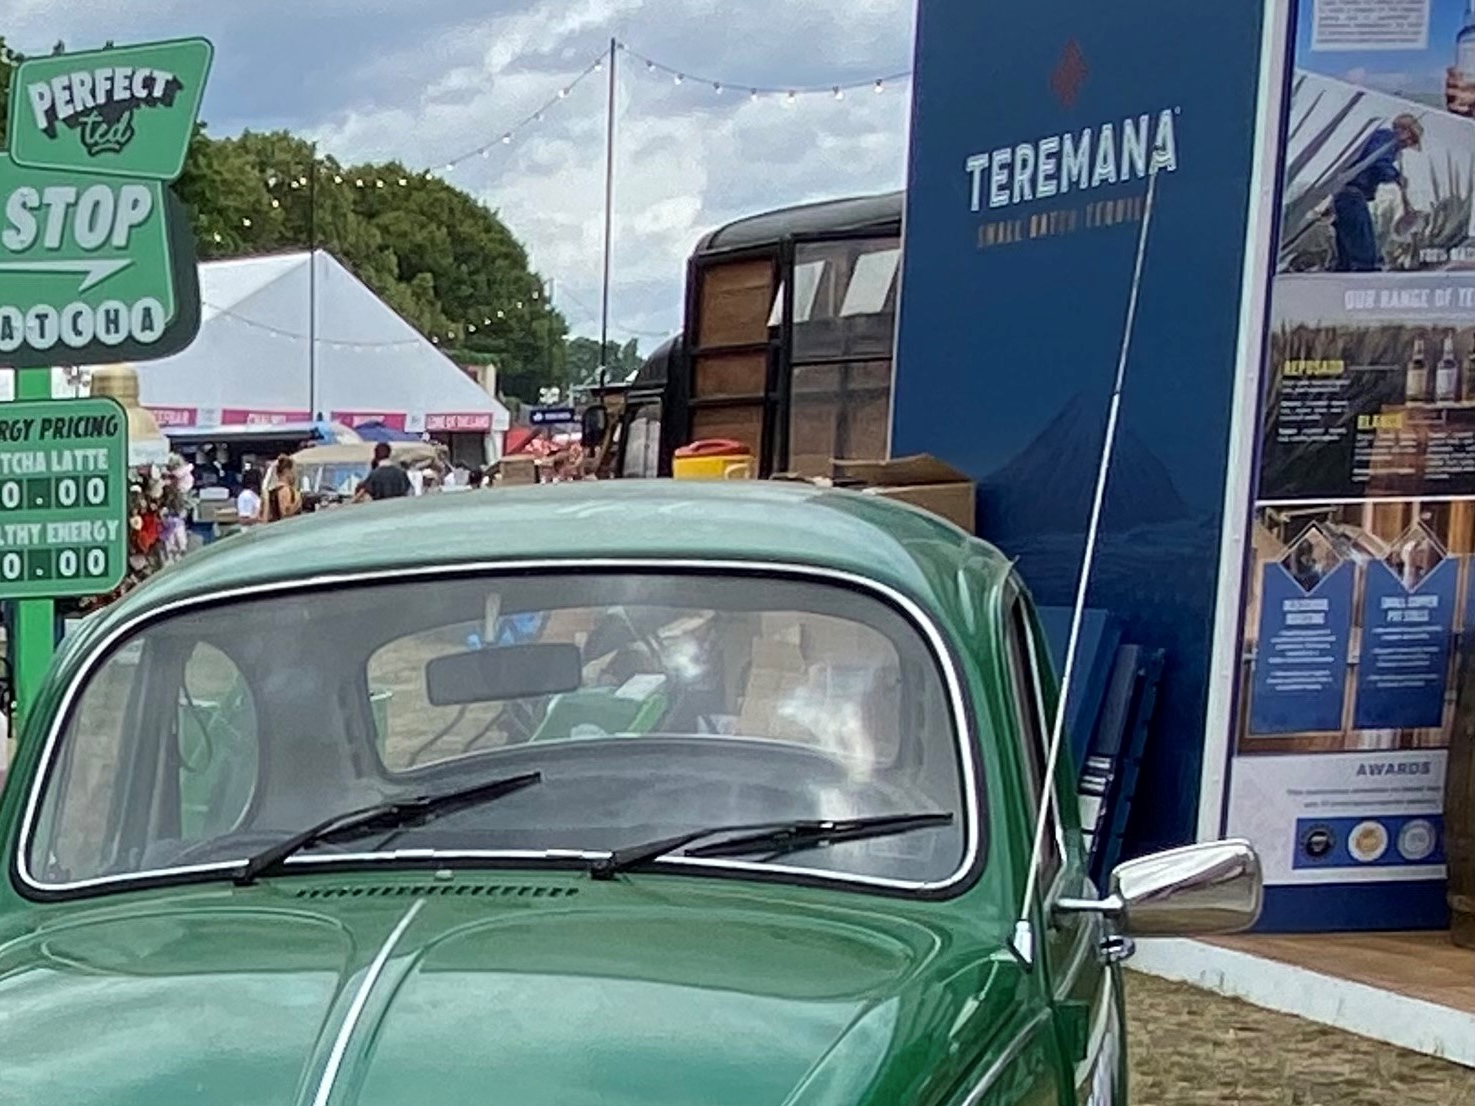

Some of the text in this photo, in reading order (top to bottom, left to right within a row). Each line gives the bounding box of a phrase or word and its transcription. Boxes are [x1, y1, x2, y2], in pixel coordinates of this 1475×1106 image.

[27, 67, 175, 130] PERFECT
[965, 108, 1177, 212] TEREMANA
[1, 184, 153, 251] STOP
[38, 414, 118, 441] PRICING
[51, 448, 108, 471] LATTE
[46, 519, 119, 543] ENERGY
[1356, 761, 1432, 777] AWARDS
